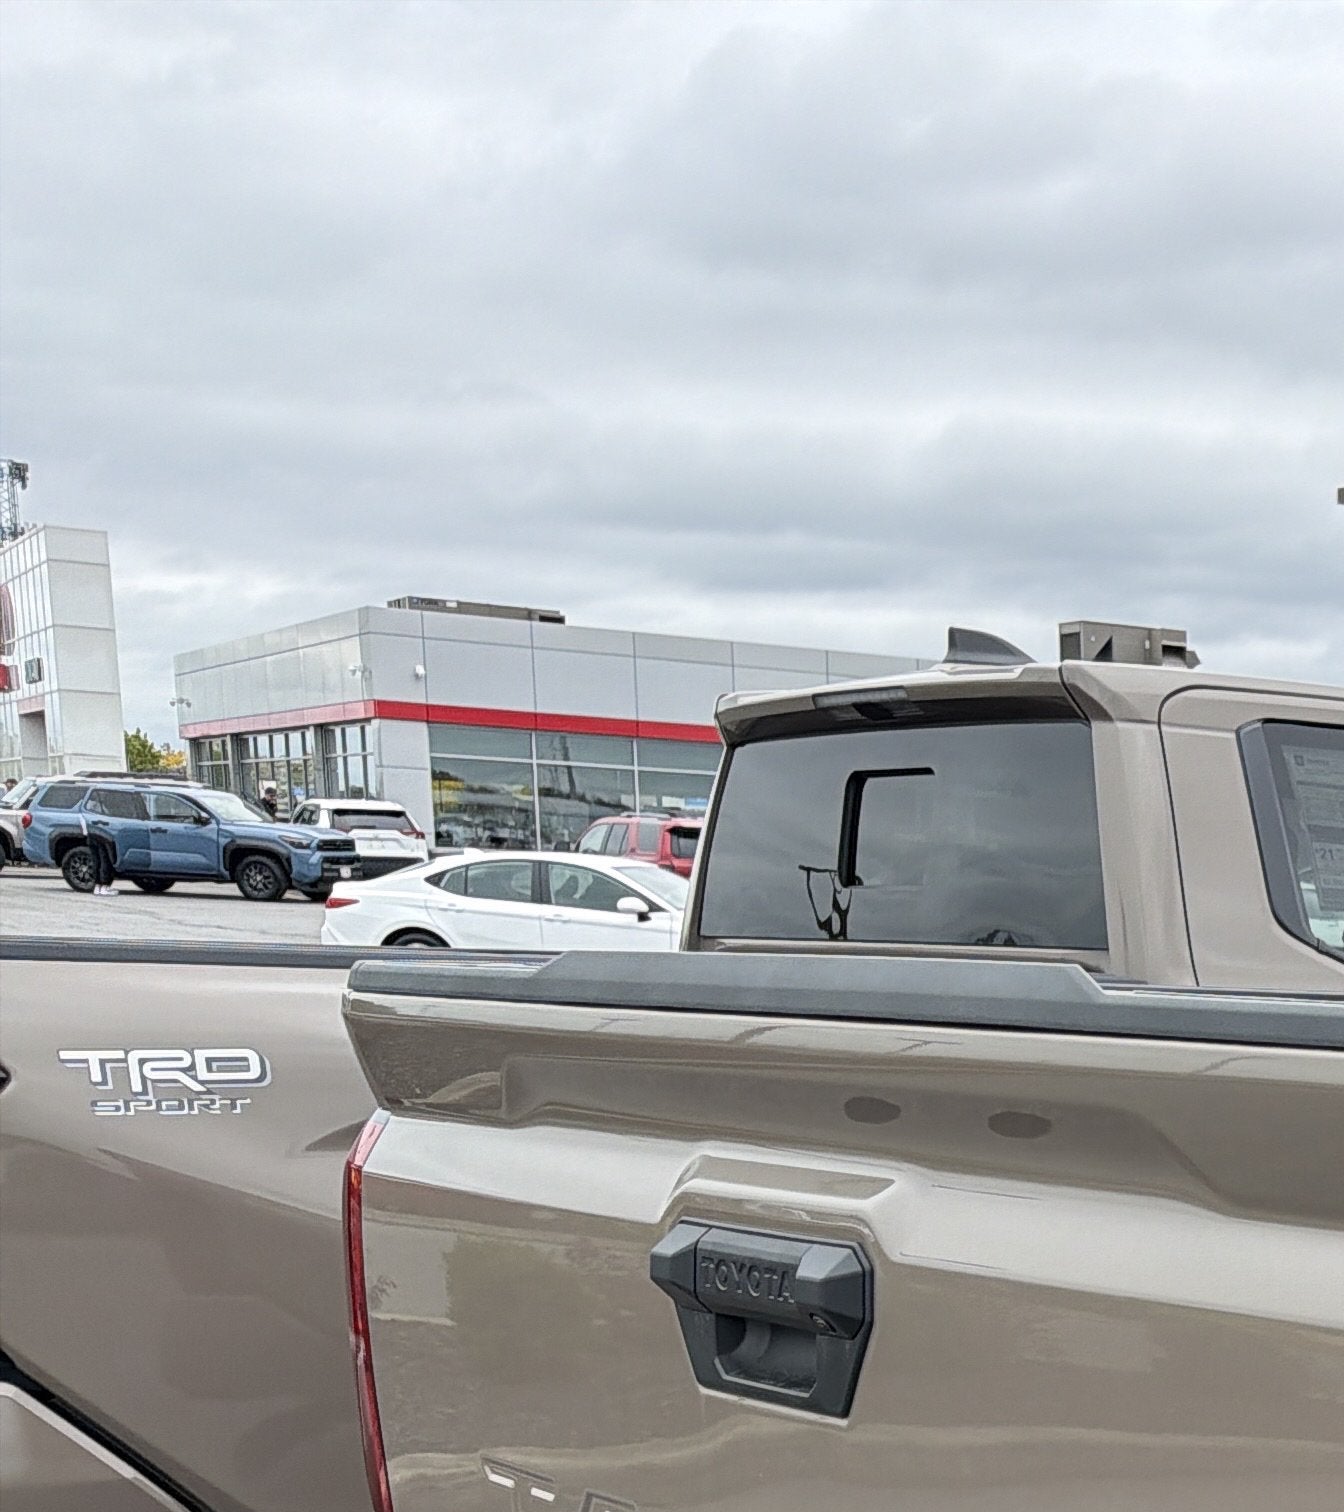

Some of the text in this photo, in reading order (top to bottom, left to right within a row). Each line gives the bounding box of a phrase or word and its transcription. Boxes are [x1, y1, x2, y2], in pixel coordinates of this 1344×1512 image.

[58, 1047, 272, 1096] TRD
[91, 1096, 252, 1117] SPORT
[698, 1254, 796, 1303] TOYOTA
